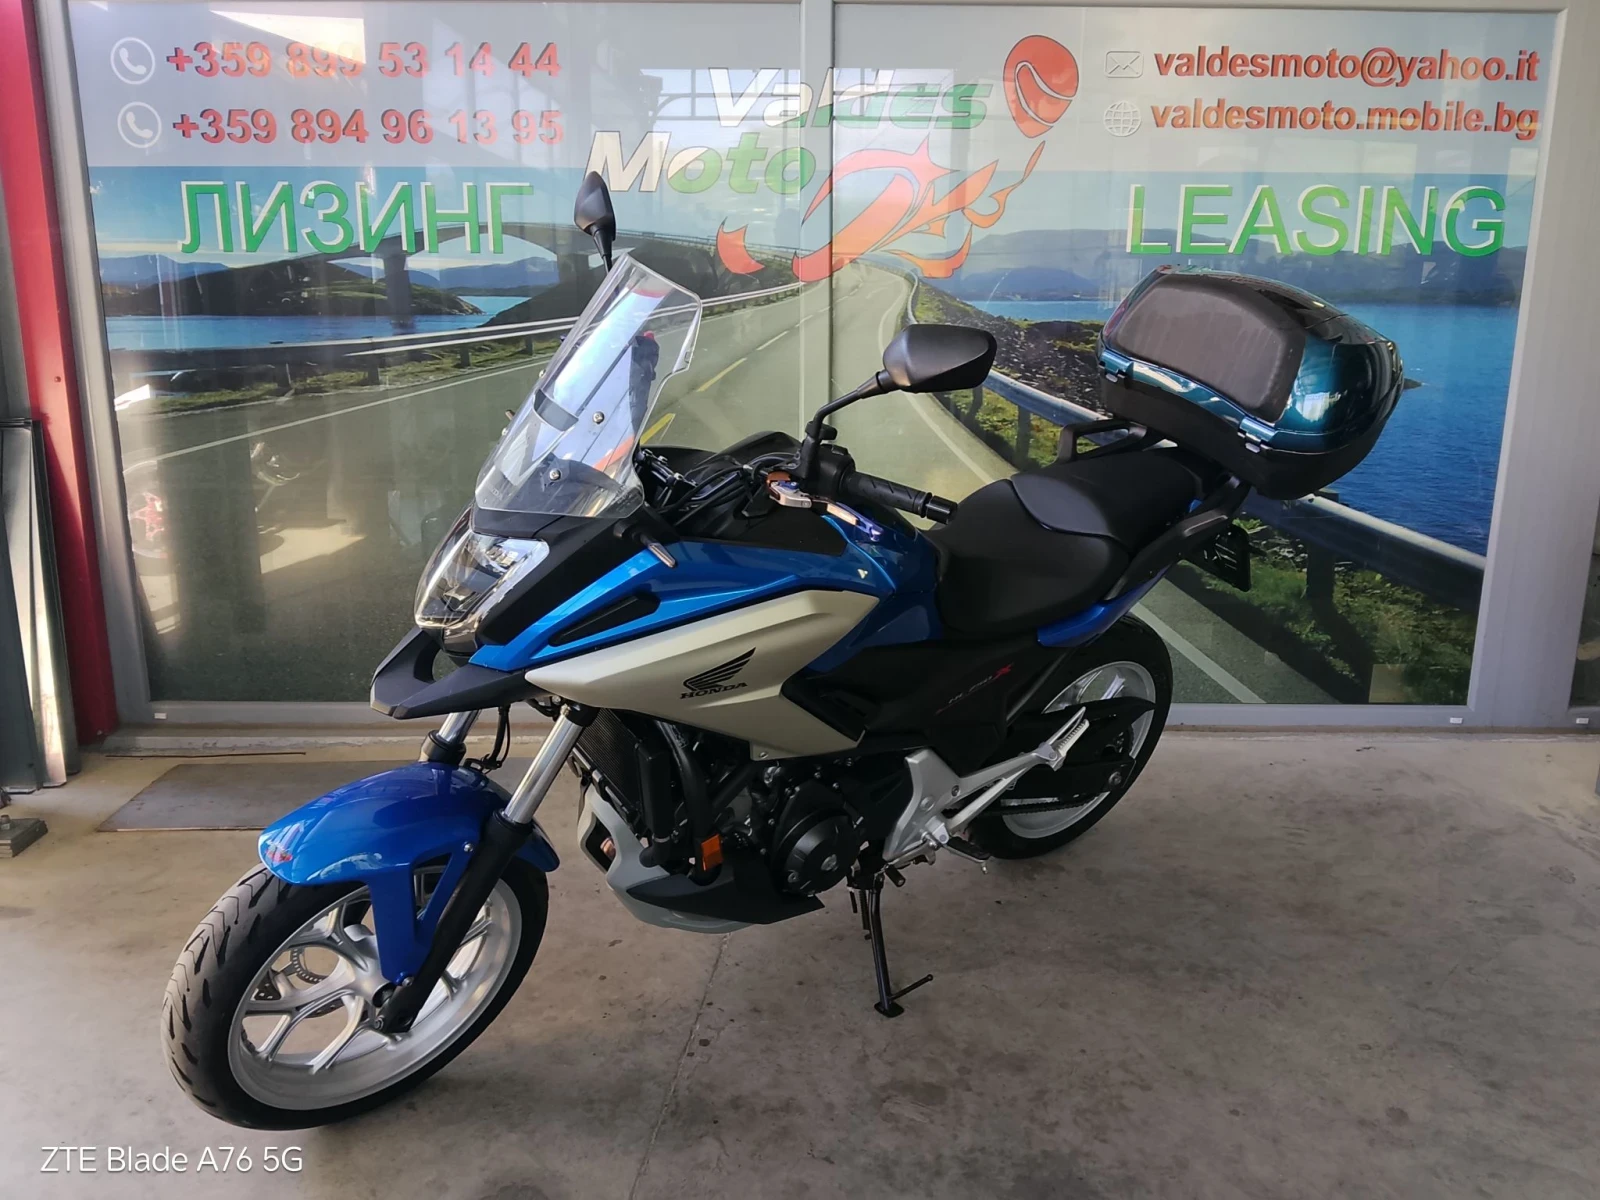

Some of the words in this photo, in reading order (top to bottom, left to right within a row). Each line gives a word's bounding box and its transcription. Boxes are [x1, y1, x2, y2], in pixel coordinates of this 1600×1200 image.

[166, 41, 271, 79] +359
[286, 42, 364, 78] 899
[378, 42, 427, 78] 53
[446, 42, 493, 78] 14
[507, 42, 561, 77] 44
[1154, 45, 1540, 87] valdesmoto@yahoo.it
[708, 67, 993, 130] Valdes
[1150, 98, 1539, 141] valdesmoto.mobile.bg
[172, 108, 277, 144] +359
[290, 109, 369, 144] 894
[382, 109, 434, 144] 96
[449, 109, 499, 144] 13
[512, 109, 564, 144] 95
[586, 131, 816, 194] Moto
[177, 180, 535, 255] ЛИЗИНГ
[1126, 183, 1506, 257] LEASING
[680, 682, 748, 699] HONDA
